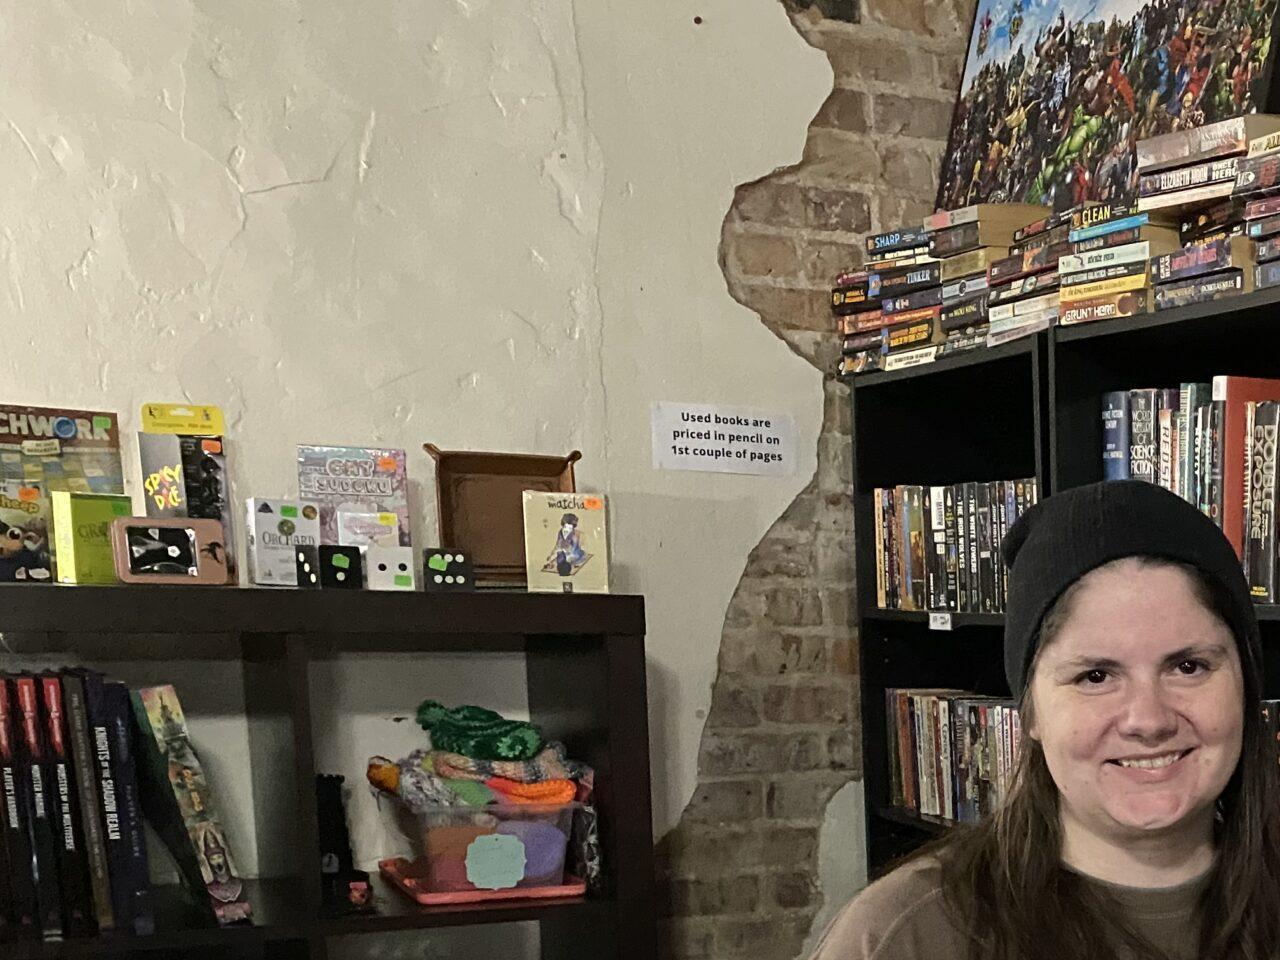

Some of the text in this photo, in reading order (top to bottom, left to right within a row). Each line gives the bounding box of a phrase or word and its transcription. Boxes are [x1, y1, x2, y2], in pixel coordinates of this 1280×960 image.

[1161, 170, 1190, 190] ELIZABETH
[1081, 205, 1112, 224] CLEAN
[874, 234, 900, 249] SHARP
[906, 270, 931, 284] TINKER
[0, 412, 110, 440] CHWORK
[681, 413, 770, 428] Used books are
[673, 429, 779, 445] priced in pencil on
[672, 445, 782, 463] 1st couple of pages
[1263, 424, 1275, 511] DOUBLE
[145, 464, 181, 494] SPICY
[1252, 424, 1263, 539] EXPOSURE
[548, 498, 586, 510] matcha
[94, 727, 121, 840] KNIGHTS SHADOW REALM
